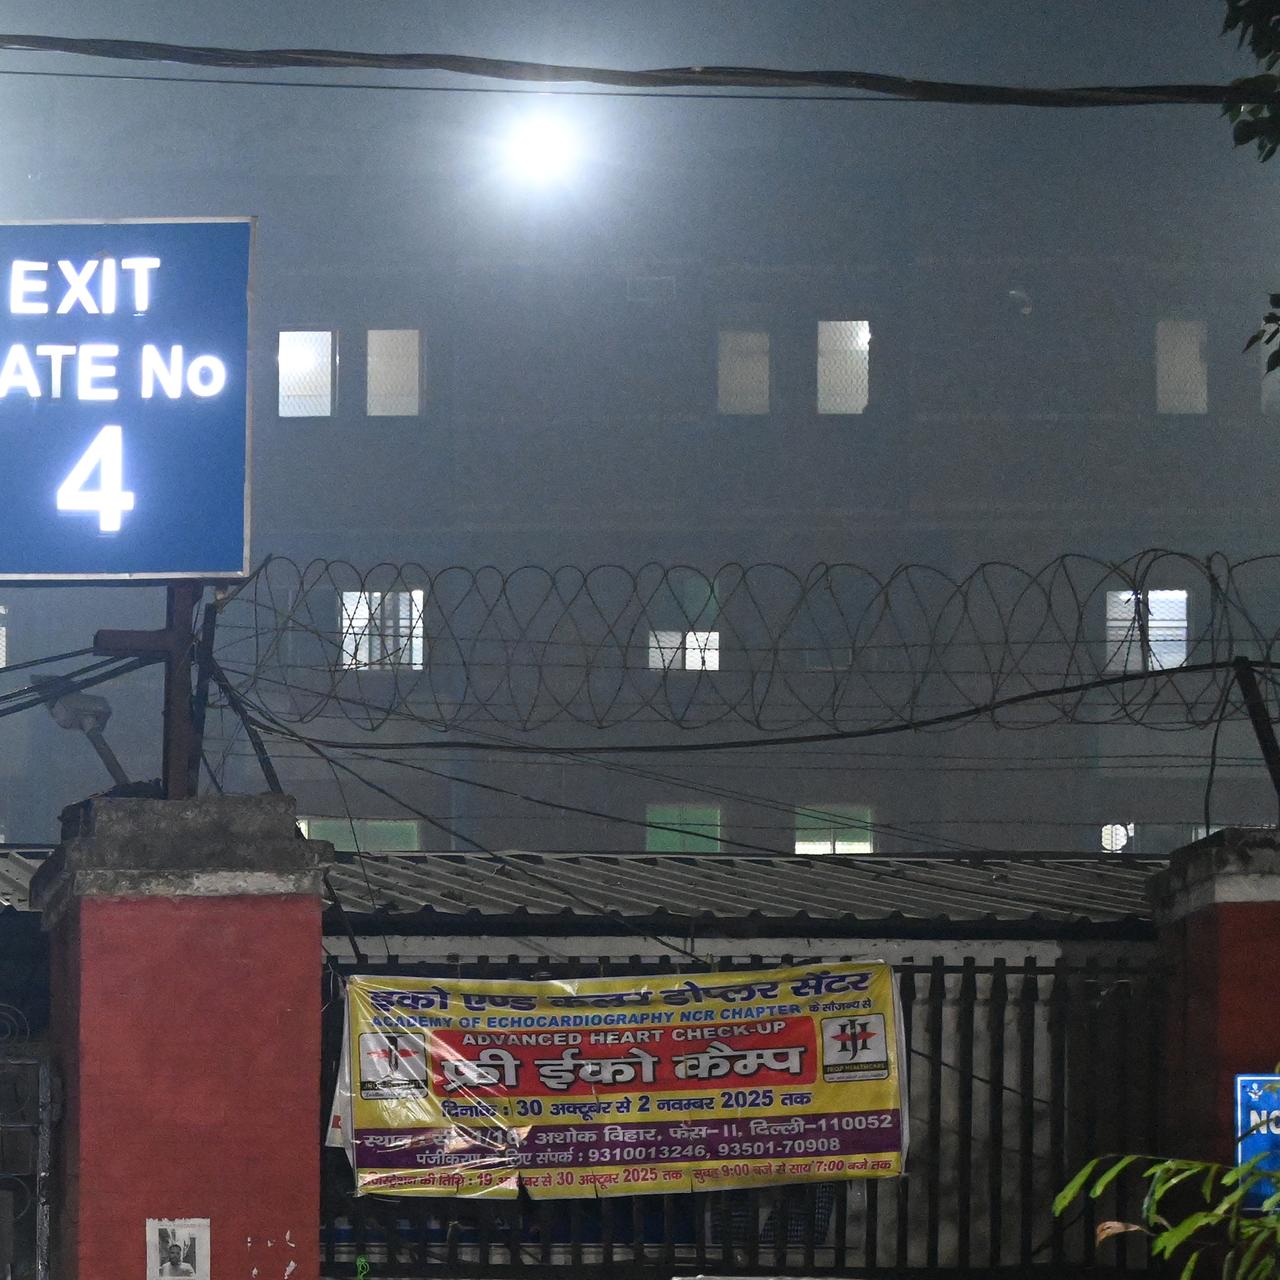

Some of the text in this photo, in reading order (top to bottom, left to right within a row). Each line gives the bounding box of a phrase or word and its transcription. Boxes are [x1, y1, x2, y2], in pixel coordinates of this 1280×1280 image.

[9, 257, 161, 315] EXIT
[141, 345, 228, 399] No
[56, 425, 135, 532] 4
[371, 1004, 802, 1029] ACADEMY OF ECHOCARDIOGRAPHY NCR CHAPTER
[462, 1020, 786, 1046] ADVANCED HEART CHECK-UP
[440, 1040, 806, 1092] फ्री ईको कैम्प
[516, 1099, 543, 1117] 30
[615, 1096, 633, 1114] से
[638, 1095, 650, 1113] 2
[656, 1097, 716, 1112] नवम्बर
[720, 1089, 774, 1109] 2025
[780, 1091, 813, 1106] तक
[534, 1127, 598, 1145] अशोक
[588, 1143, 711, 1163] 9310013246,
[718, 1137, 841, 1157] 93501-70908
[557, 1171, 574, 1186] 30
[623, 1167, 658, 1183] 2025
[662, 1169, 683, 1181] तक
[721, 1163, 750, 1177] 9:00
[871, 1159, 893, 1171] तक
